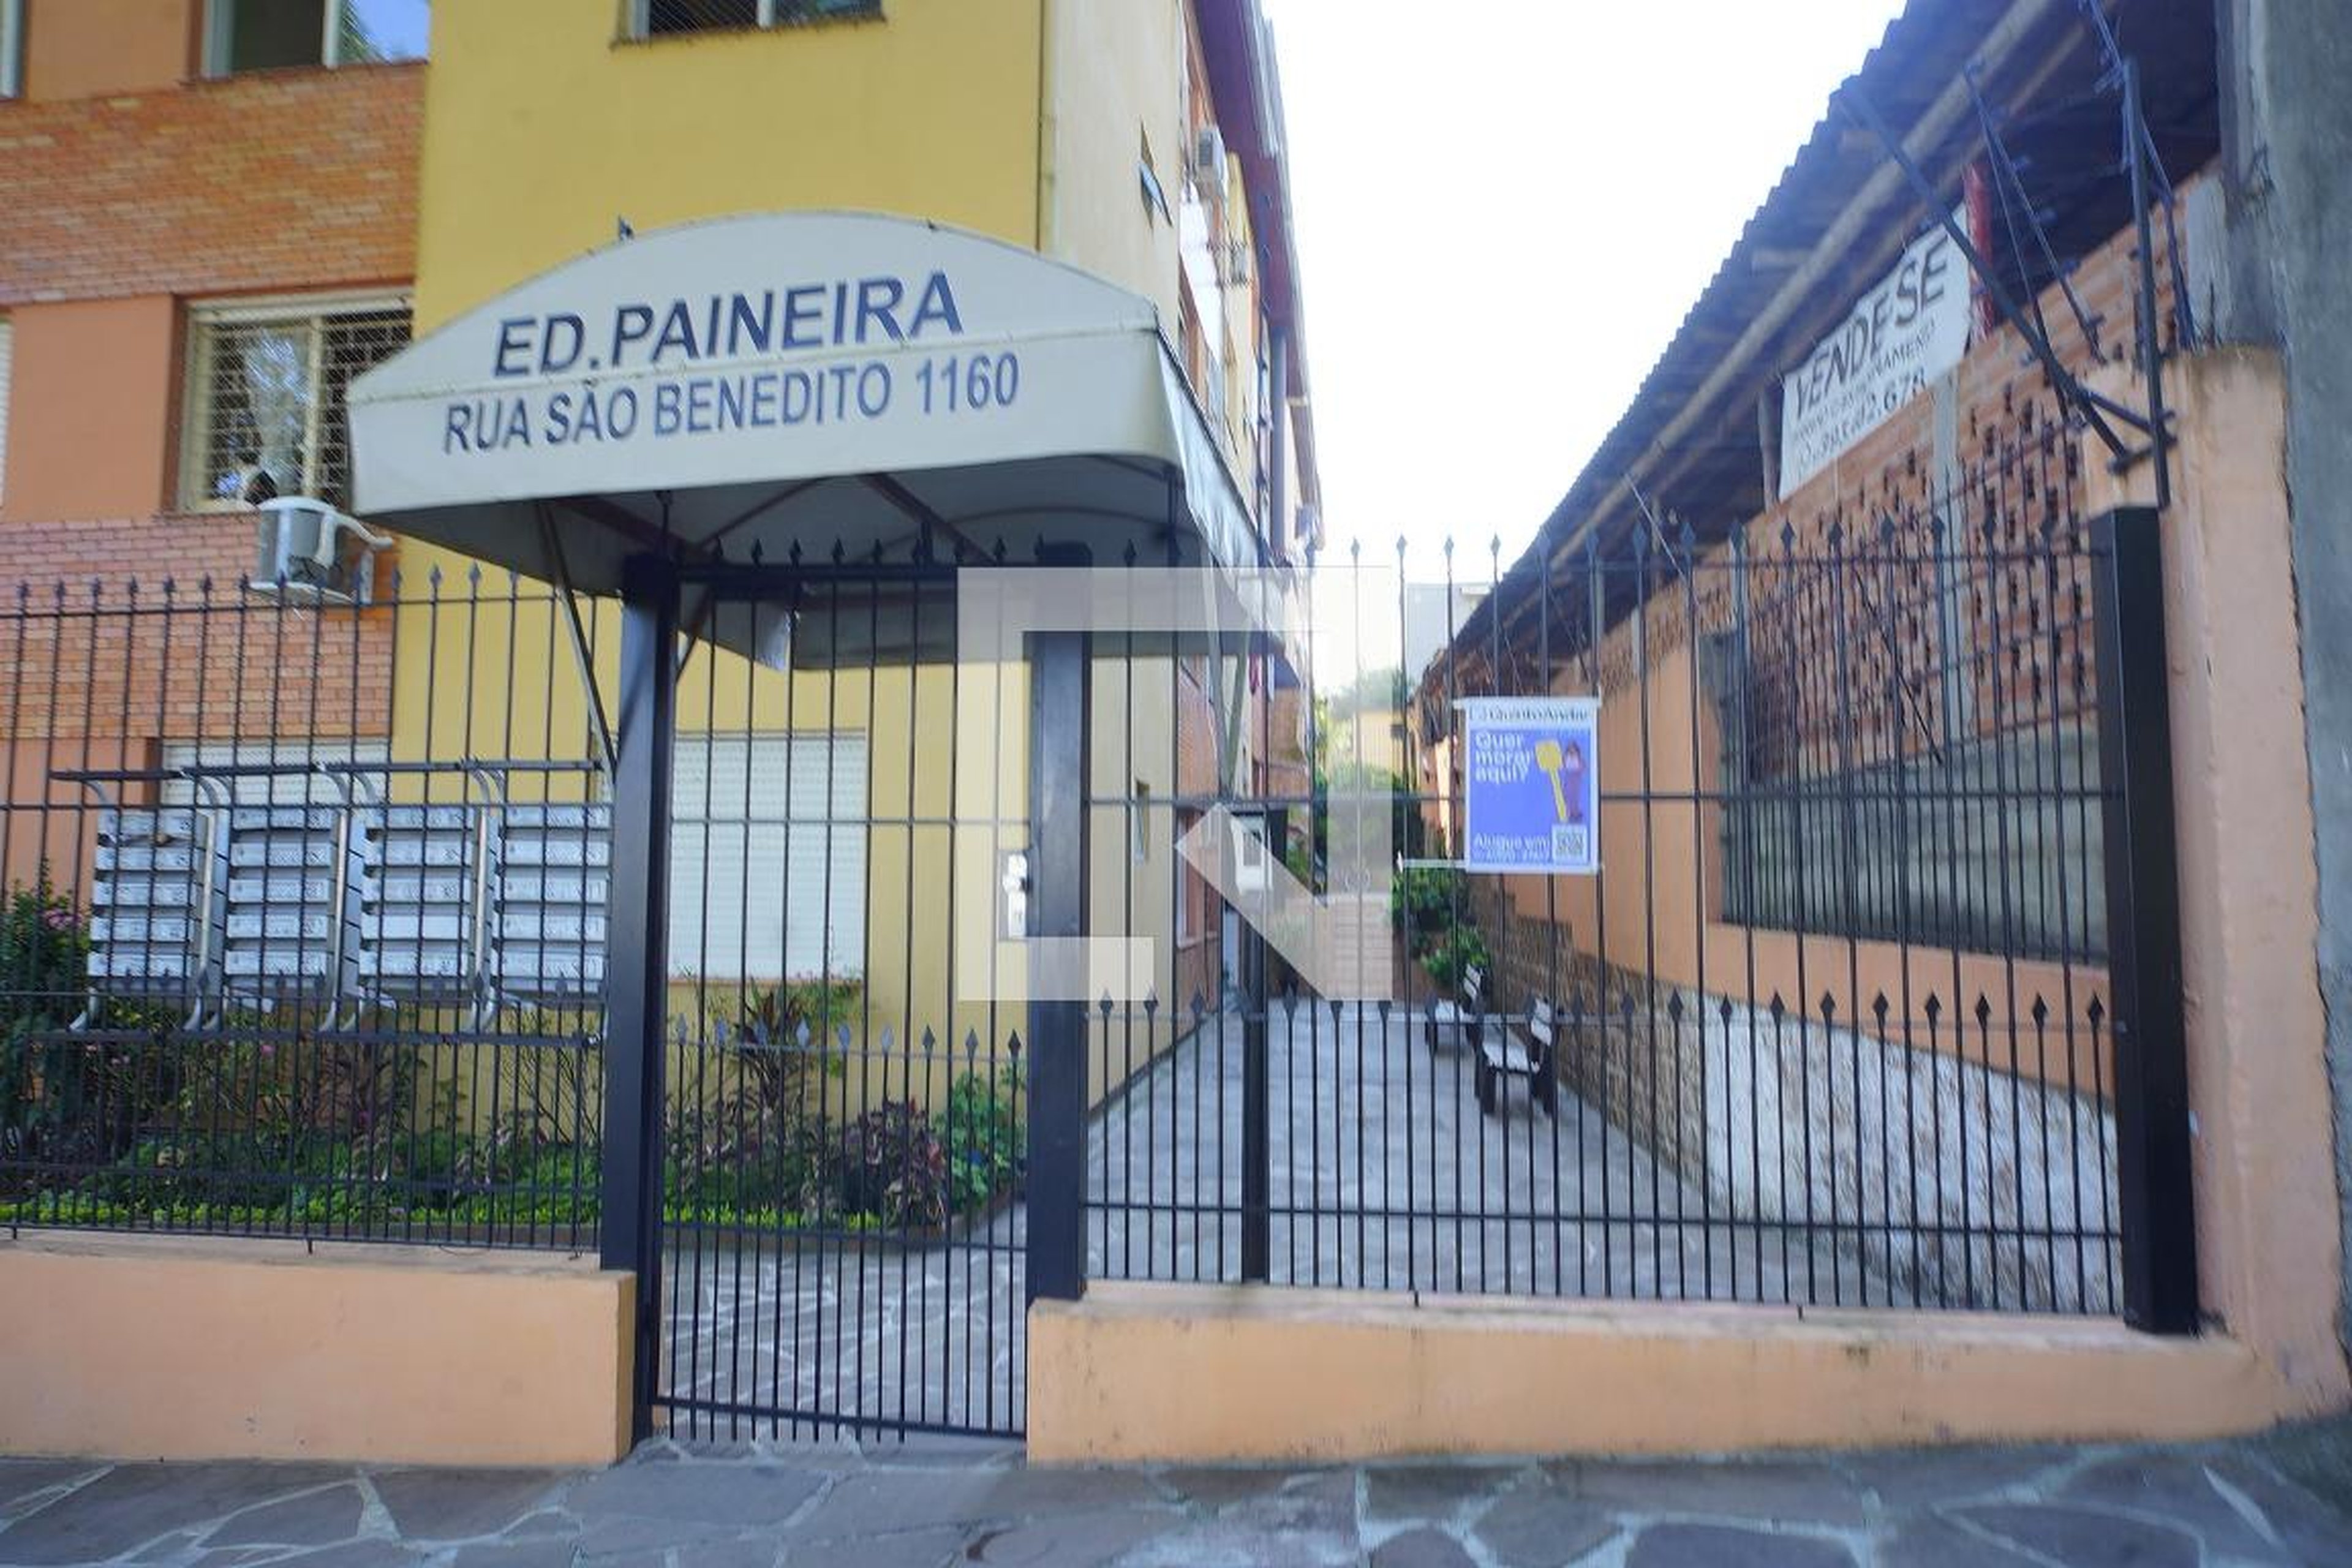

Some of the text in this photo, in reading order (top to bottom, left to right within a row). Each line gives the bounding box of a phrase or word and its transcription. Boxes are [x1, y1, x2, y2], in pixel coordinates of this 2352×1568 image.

[443, 352, 1019, 454] RUA SÃO BENEDITO 1160
[1476, 732, 1523, 748] Quer
[1476, 750, 1533, 764] morar
[1476, 765, 1528, 784] aqui?
